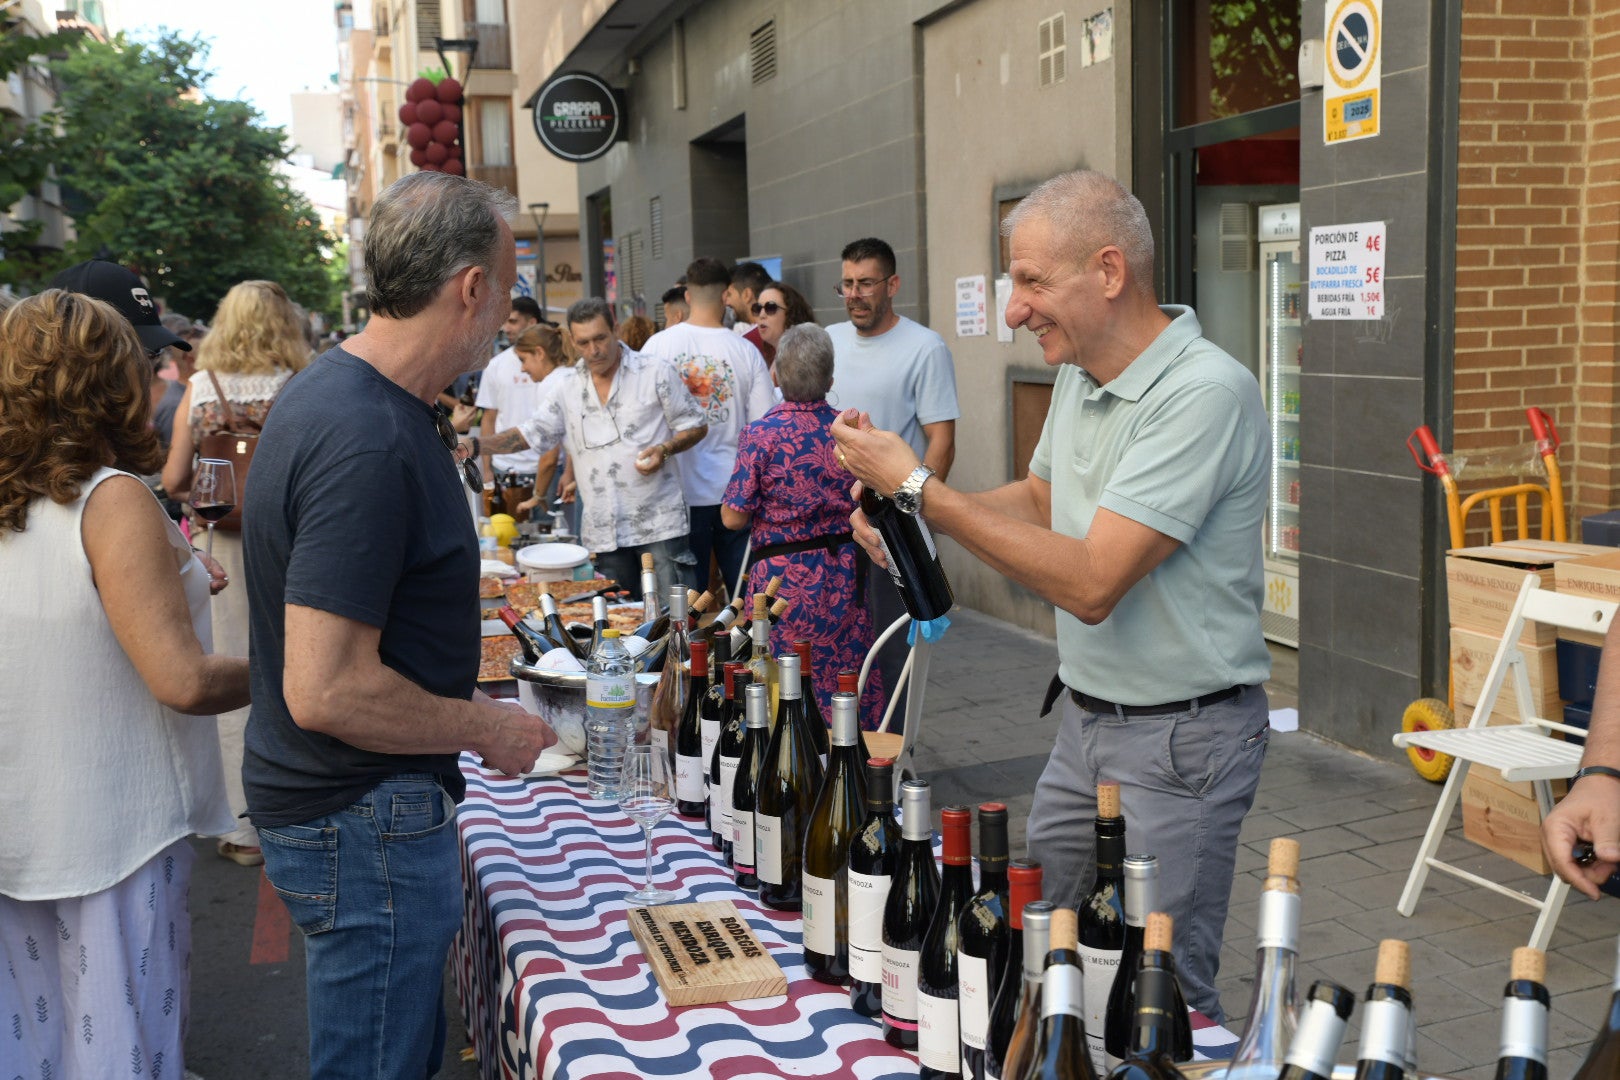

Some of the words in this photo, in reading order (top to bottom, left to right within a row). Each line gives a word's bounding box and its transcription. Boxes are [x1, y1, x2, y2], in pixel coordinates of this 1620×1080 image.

[553, 101, 601, 117] GRAPPA
[1351, 104, 1369, 116] 2025
[550, 120, 606, 128] PIZZERIA
[1315, 231, 1347, 244] PORCIÓN
[1348, 231, 1358, 242] DE
[1365, 235, 1380, 251] 4€
[1325, 250, 1347, 261] PIZZA
[1316, 266, 1348, 275] BOCADILLO
[1349, 265, 1357, 274] DE
[1365, 267, 1380, 283] 5€
[1310, 280, 1340, 289] BUTIFARRA
[1341, 279, 1363, 288] FRESCA
[1317, 294, 1341, 303] BEBIDAS
[1342, 292, 1355, 302] FRÍA
[1361, 292, 1380, 303] 1,50€
[1321, 307, 1337, 316] AGUA
[1338, 306, 1351, 316] FRÍA
[1367, 306, 1375, 316] 1€
[1456, 570, 1486, 587] ENRIQUE
[1567, 577, 1604, 594] ENRIQUE
[669, 920, 711, 965] MENDOZA
[694, 920, 735, 959] ENRIQUE
[720, 916, 762, 957] BODEGAS
[658, 942, 683, 973] VENDIMIA
